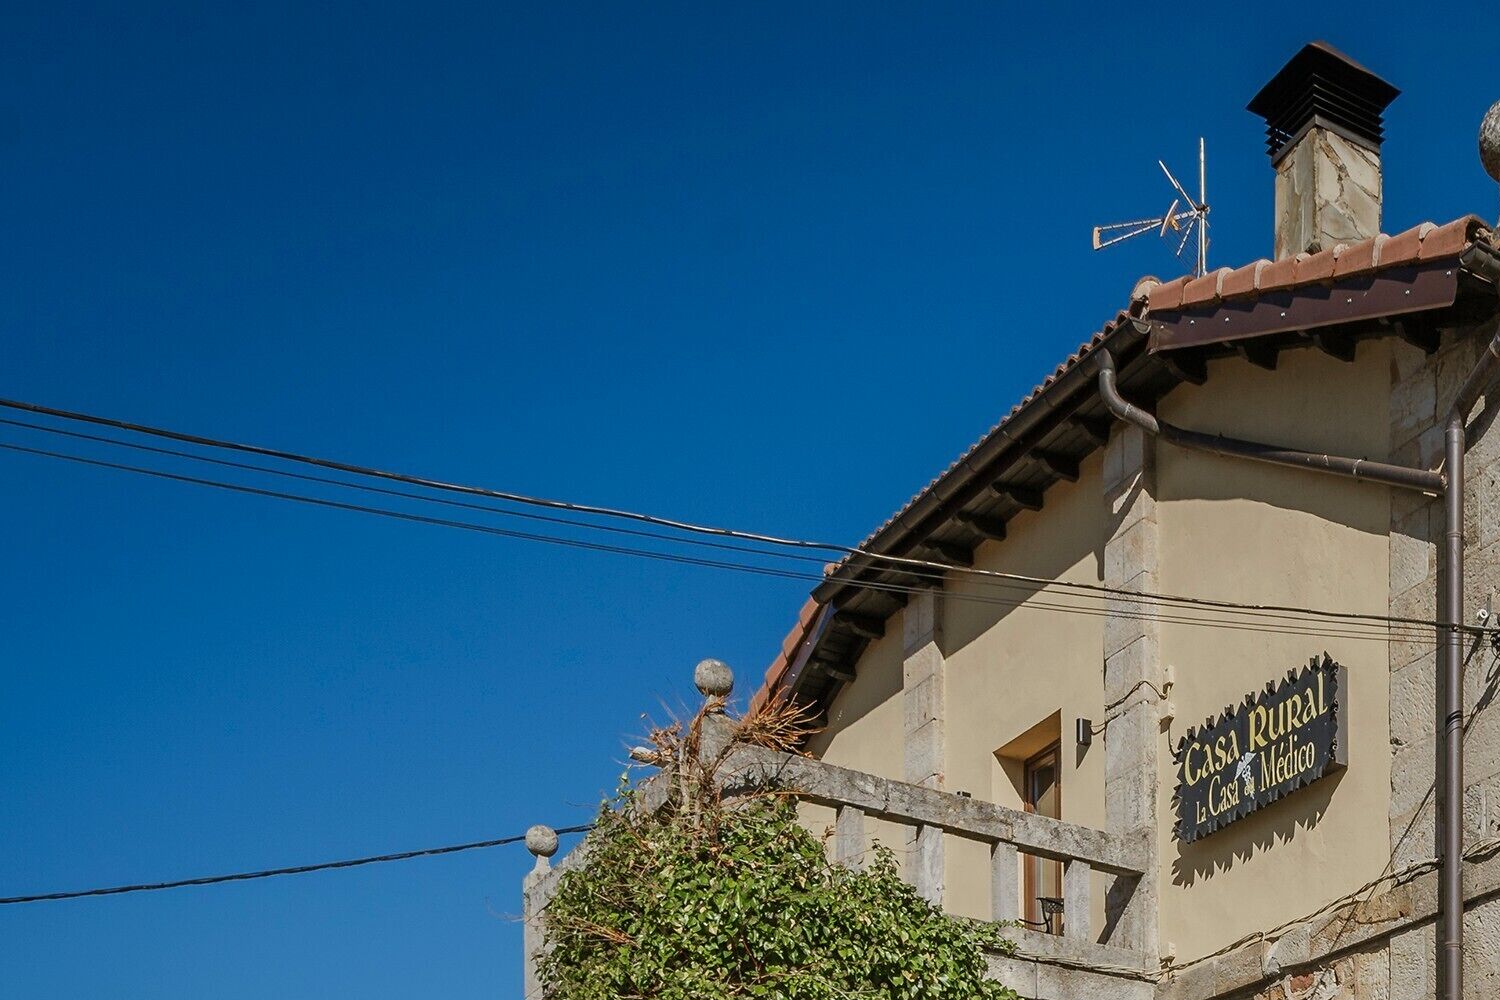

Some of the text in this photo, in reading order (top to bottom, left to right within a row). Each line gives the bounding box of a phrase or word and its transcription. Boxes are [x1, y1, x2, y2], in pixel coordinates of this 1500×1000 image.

[1184, 729, 1240, 786] Casa
[1196, 801, 1207, 825] La
[1209, 775, 1240, 816] Casa
[1260, 734, 1315, 792] Médico
